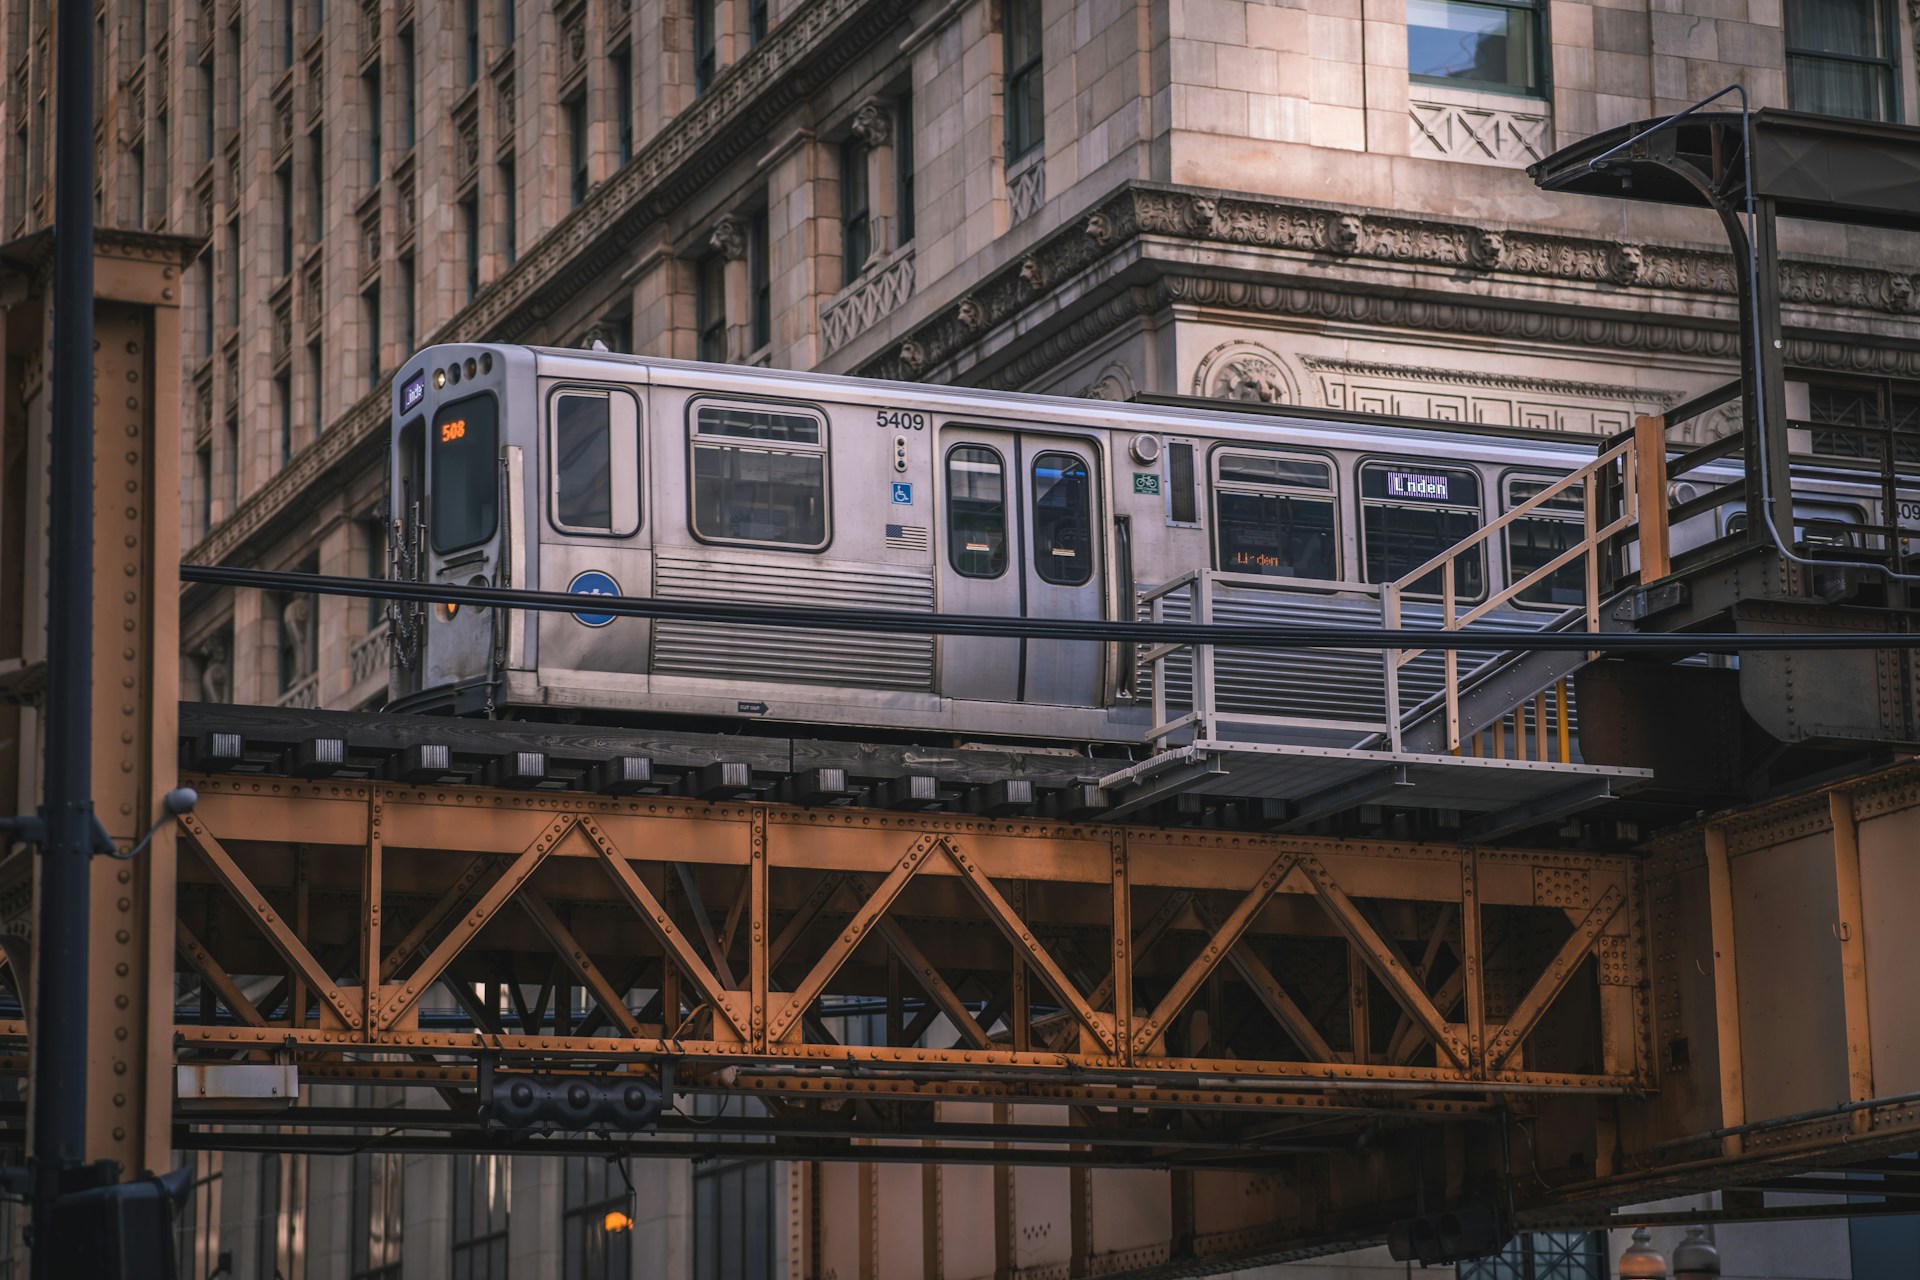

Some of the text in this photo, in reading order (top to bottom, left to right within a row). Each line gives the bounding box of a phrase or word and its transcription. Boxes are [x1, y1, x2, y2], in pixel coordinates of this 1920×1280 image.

[442, 420, 465, 442] 508
[876, 410, 924, 431] 5409
[1394, 476, 1446, 495] Lnden
